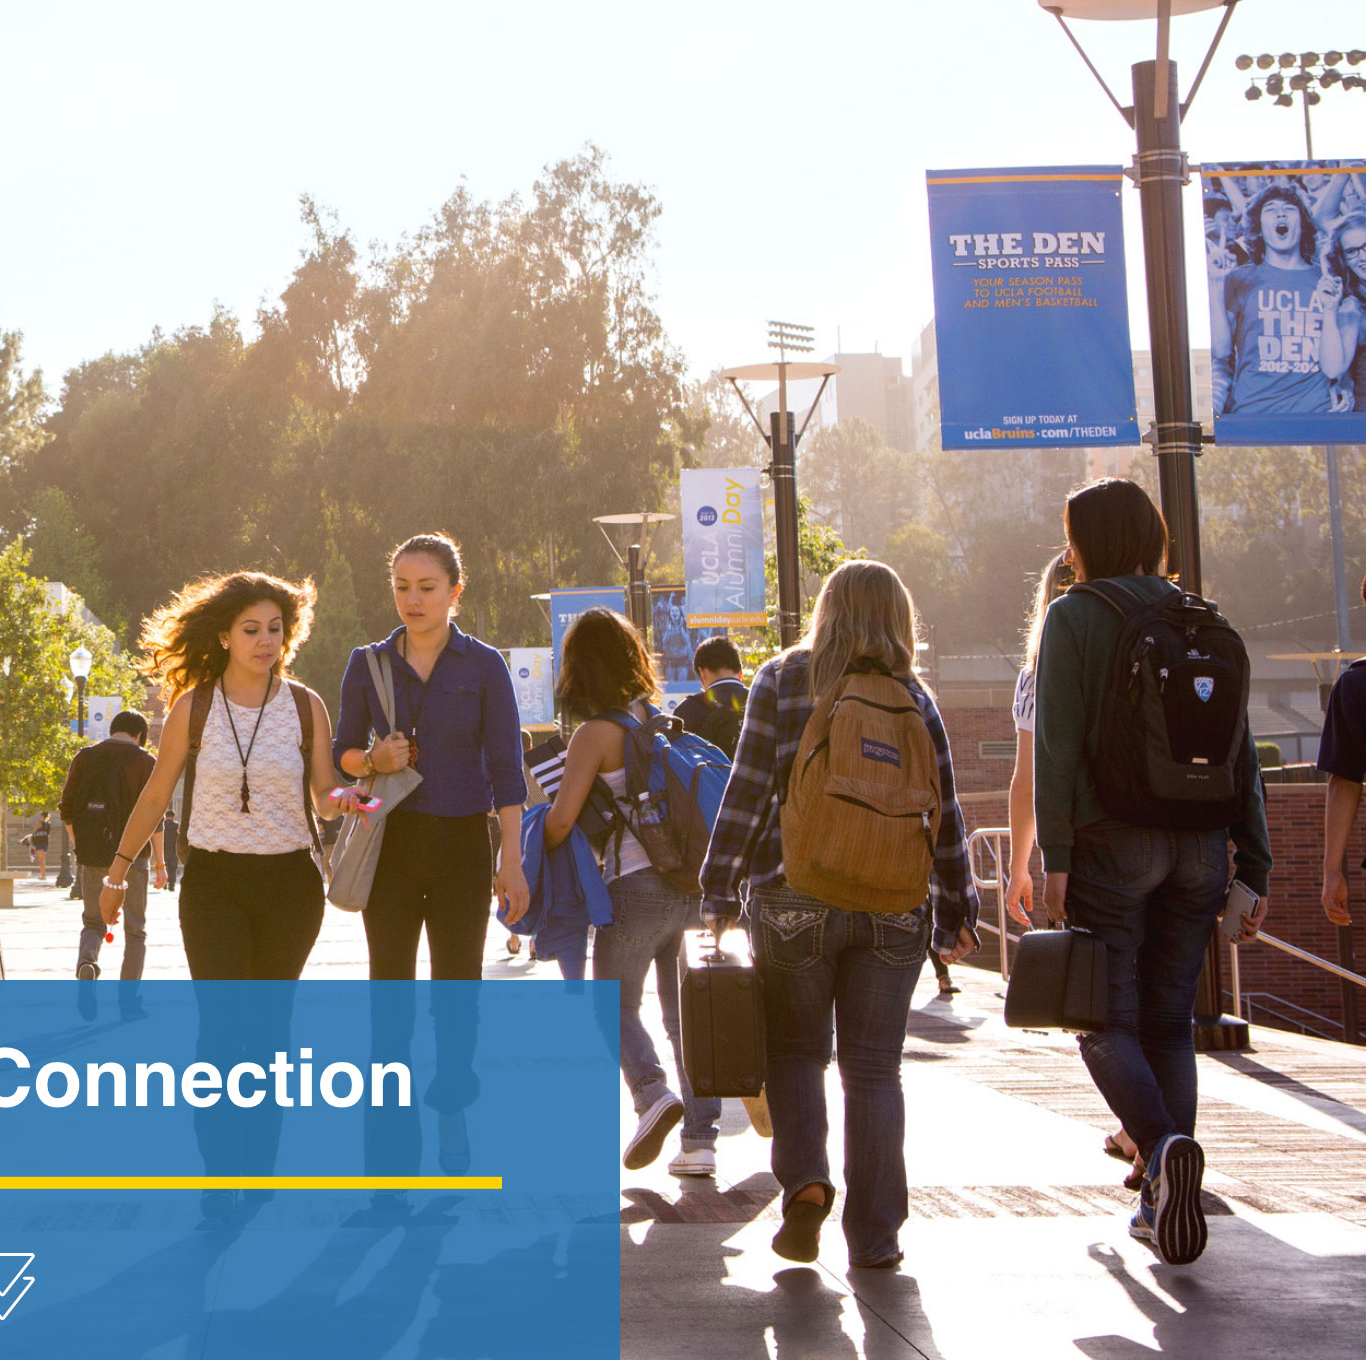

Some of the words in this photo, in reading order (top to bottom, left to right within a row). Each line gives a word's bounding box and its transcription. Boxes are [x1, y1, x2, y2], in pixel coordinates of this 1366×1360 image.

[949, 232, 1024, 257] THE
[1032, 231, 1106, 255] DEN
[978, 256, 1040, 270] SPORTS
[1044, 256, 1080, 268] PASS
[973, 277, 1004, 287] YOUR
[1009, 276, 1054, 287] SEASON
[1058, 276, 1083, 286] PASS
[974, 288, 990, 298] TO
[995, 287, 1025, 298] UCLA
[1028, 287, 1083, 297] FOOTBALL
[964, 299, 990, 309] AND
[994, 298, 1031, 308] MEN'S
[1036, 297, 1099, 308] BASKETBALL
[1258, 289, 1323, 313] UCLA
[1258, 310, 1323, 337] THE
[1258, 335, 1321, 362] DEN
[1003, 416, 1024, 425] SIGN
[1025, 415, 1037, 425] UP
[1039, 415, 1065, 425] TODAY
[1067, 414, 1078, 423] AT
[722, 477, 746, 525] Day
[701, 532, 720, 586] UCLA
[724, 528, 746, 610] Alumni
